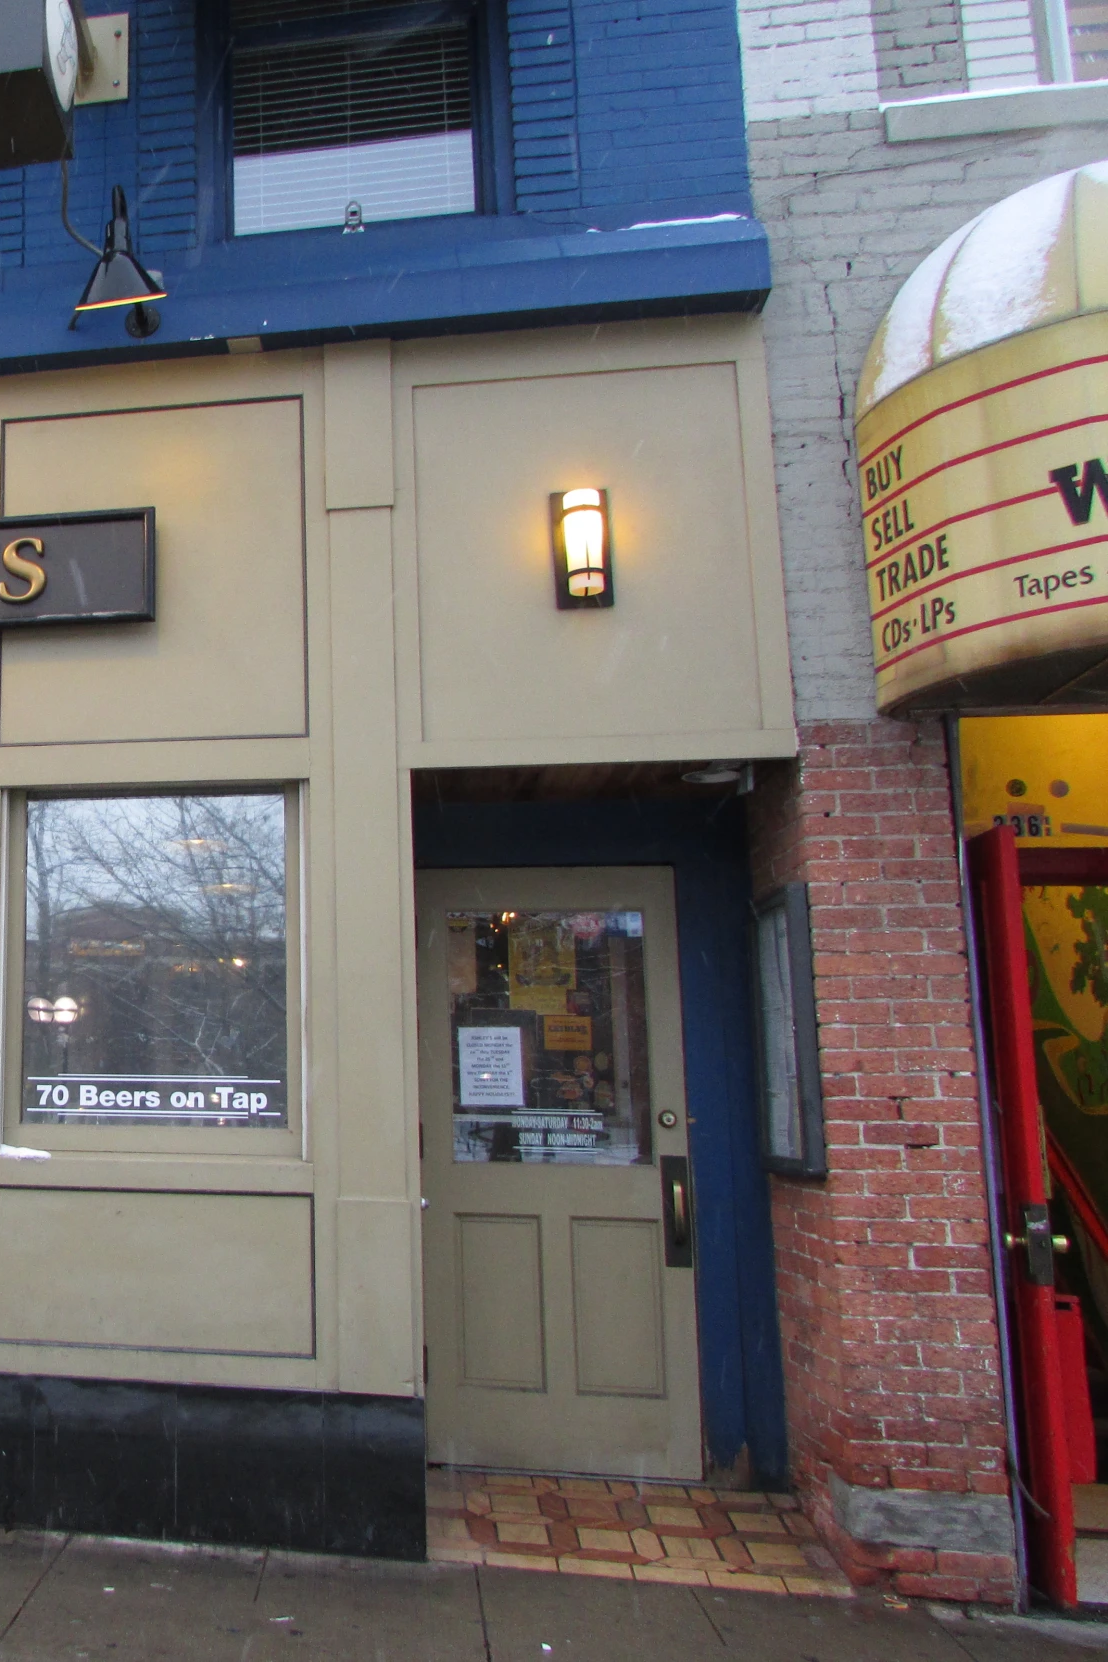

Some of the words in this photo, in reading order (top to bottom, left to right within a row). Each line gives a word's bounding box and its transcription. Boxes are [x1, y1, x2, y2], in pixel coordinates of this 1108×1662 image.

[865, 445, 904, 501] BUY
[871, 499, 916, 551] SELL
[875, 534, 950, 602] TRADE
[1013, 565, 1095, 600] Tapes
[36, 1084, 69, 1106] 70
[79, 1085, 160, 1107] Beers
[170, 1090, 204, 1108] on
[215, 1086, 268, 1114] Tap
[518, 1132, 543, 1145] SUNDAY
